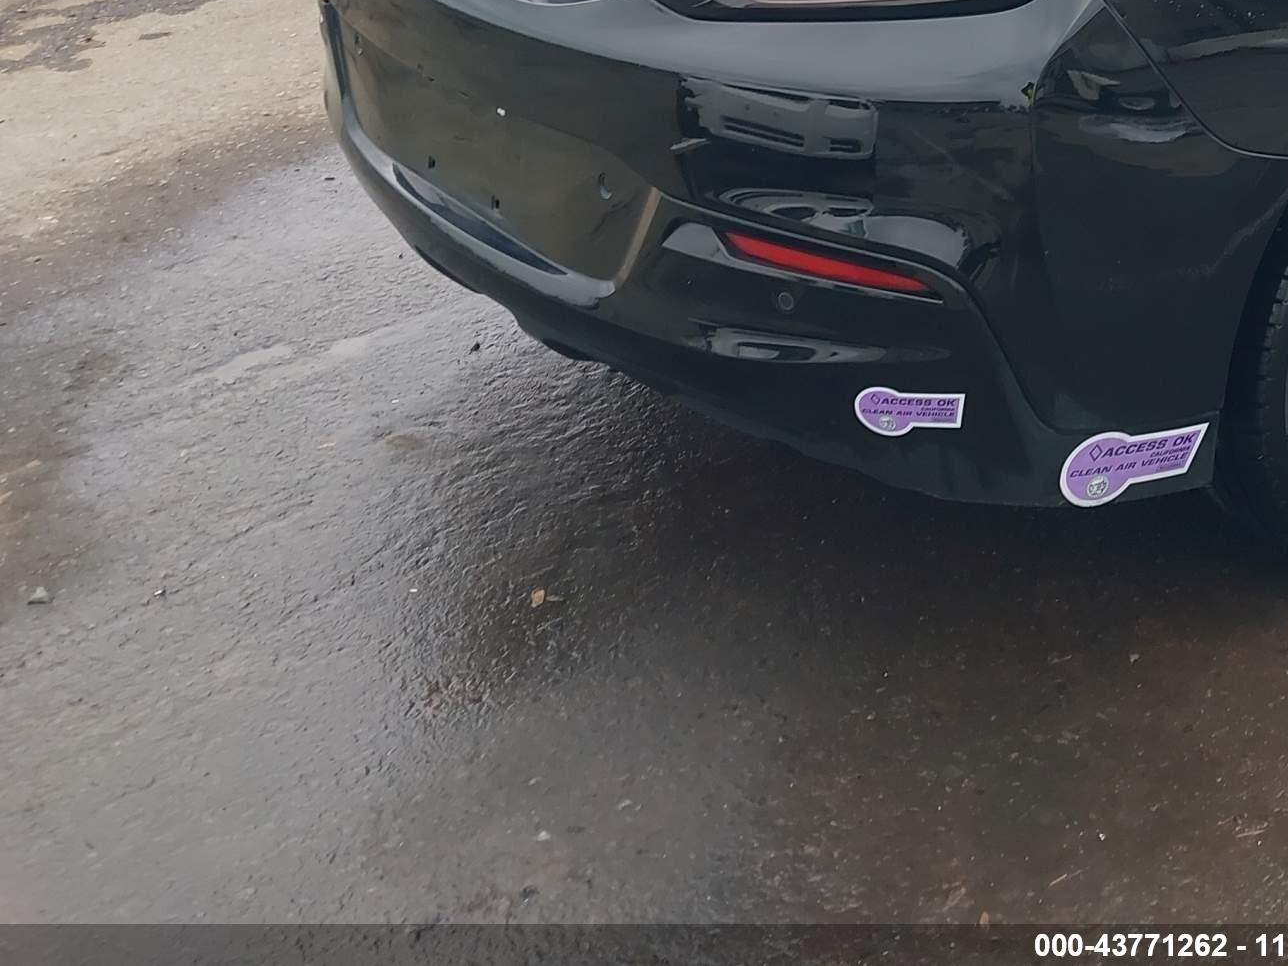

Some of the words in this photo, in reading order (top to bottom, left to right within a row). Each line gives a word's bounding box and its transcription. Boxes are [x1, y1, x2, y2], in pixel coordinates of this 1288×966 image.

[881, 397, 932, 407] ACCESS
[937, 398, 956, 407] OK
[1101, 438, 1169, 459] ACCESS
[1172, 433, 1196, 447] OK
[1150, 445, 1191, 458] CALIFORNIA
[1069, 464, 1113, 478] CLEAN
[1116, 461, 1137, 471] AIR
[1141, 452, 1188, 467] VEHICLE
